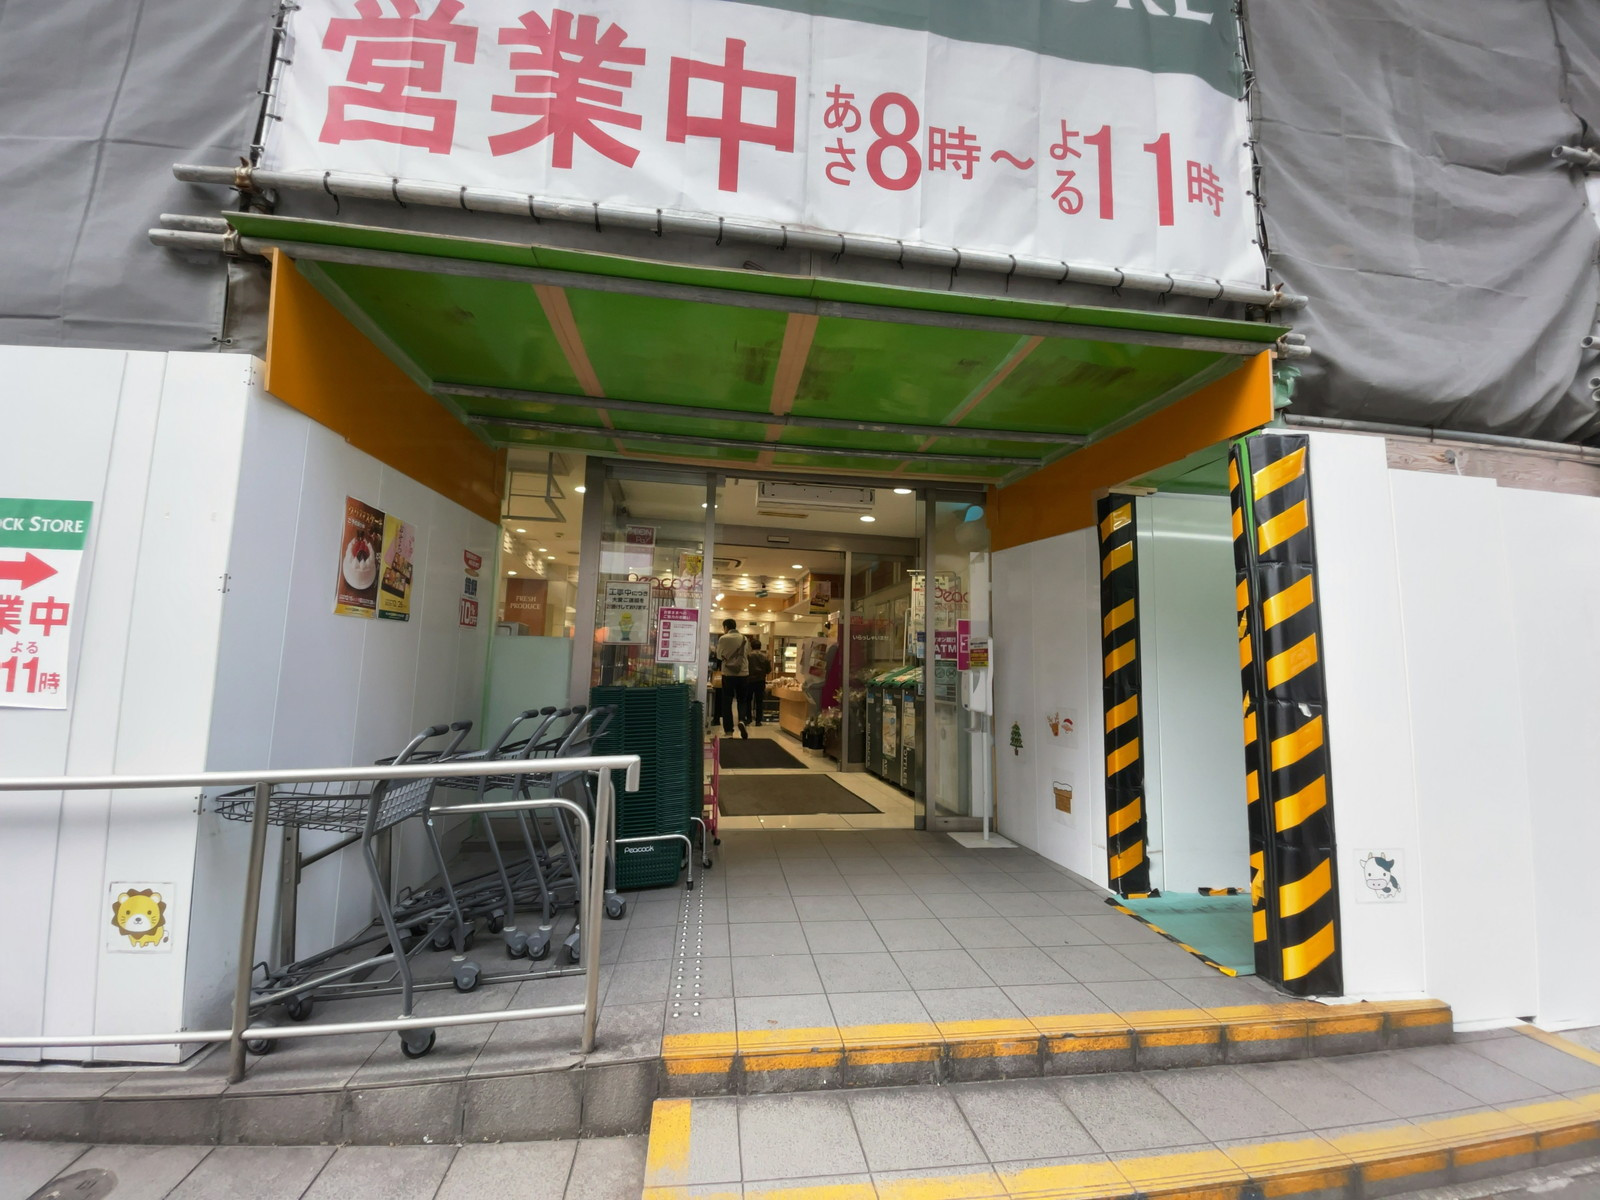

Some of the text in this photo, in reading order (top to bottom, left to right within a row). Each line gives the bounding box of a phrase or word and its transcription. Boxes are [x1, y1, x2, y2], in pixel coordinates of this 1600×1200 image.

[320, 0, 797, 192] 営業中
[0, 515, 84, 534] CK STORE
[509, 602, 541, 610] PRODUCE
[10, 641, 39, 654] よる
[935, 643, 958, 653] ATM
[624, 845, 654, 853] Peacock
